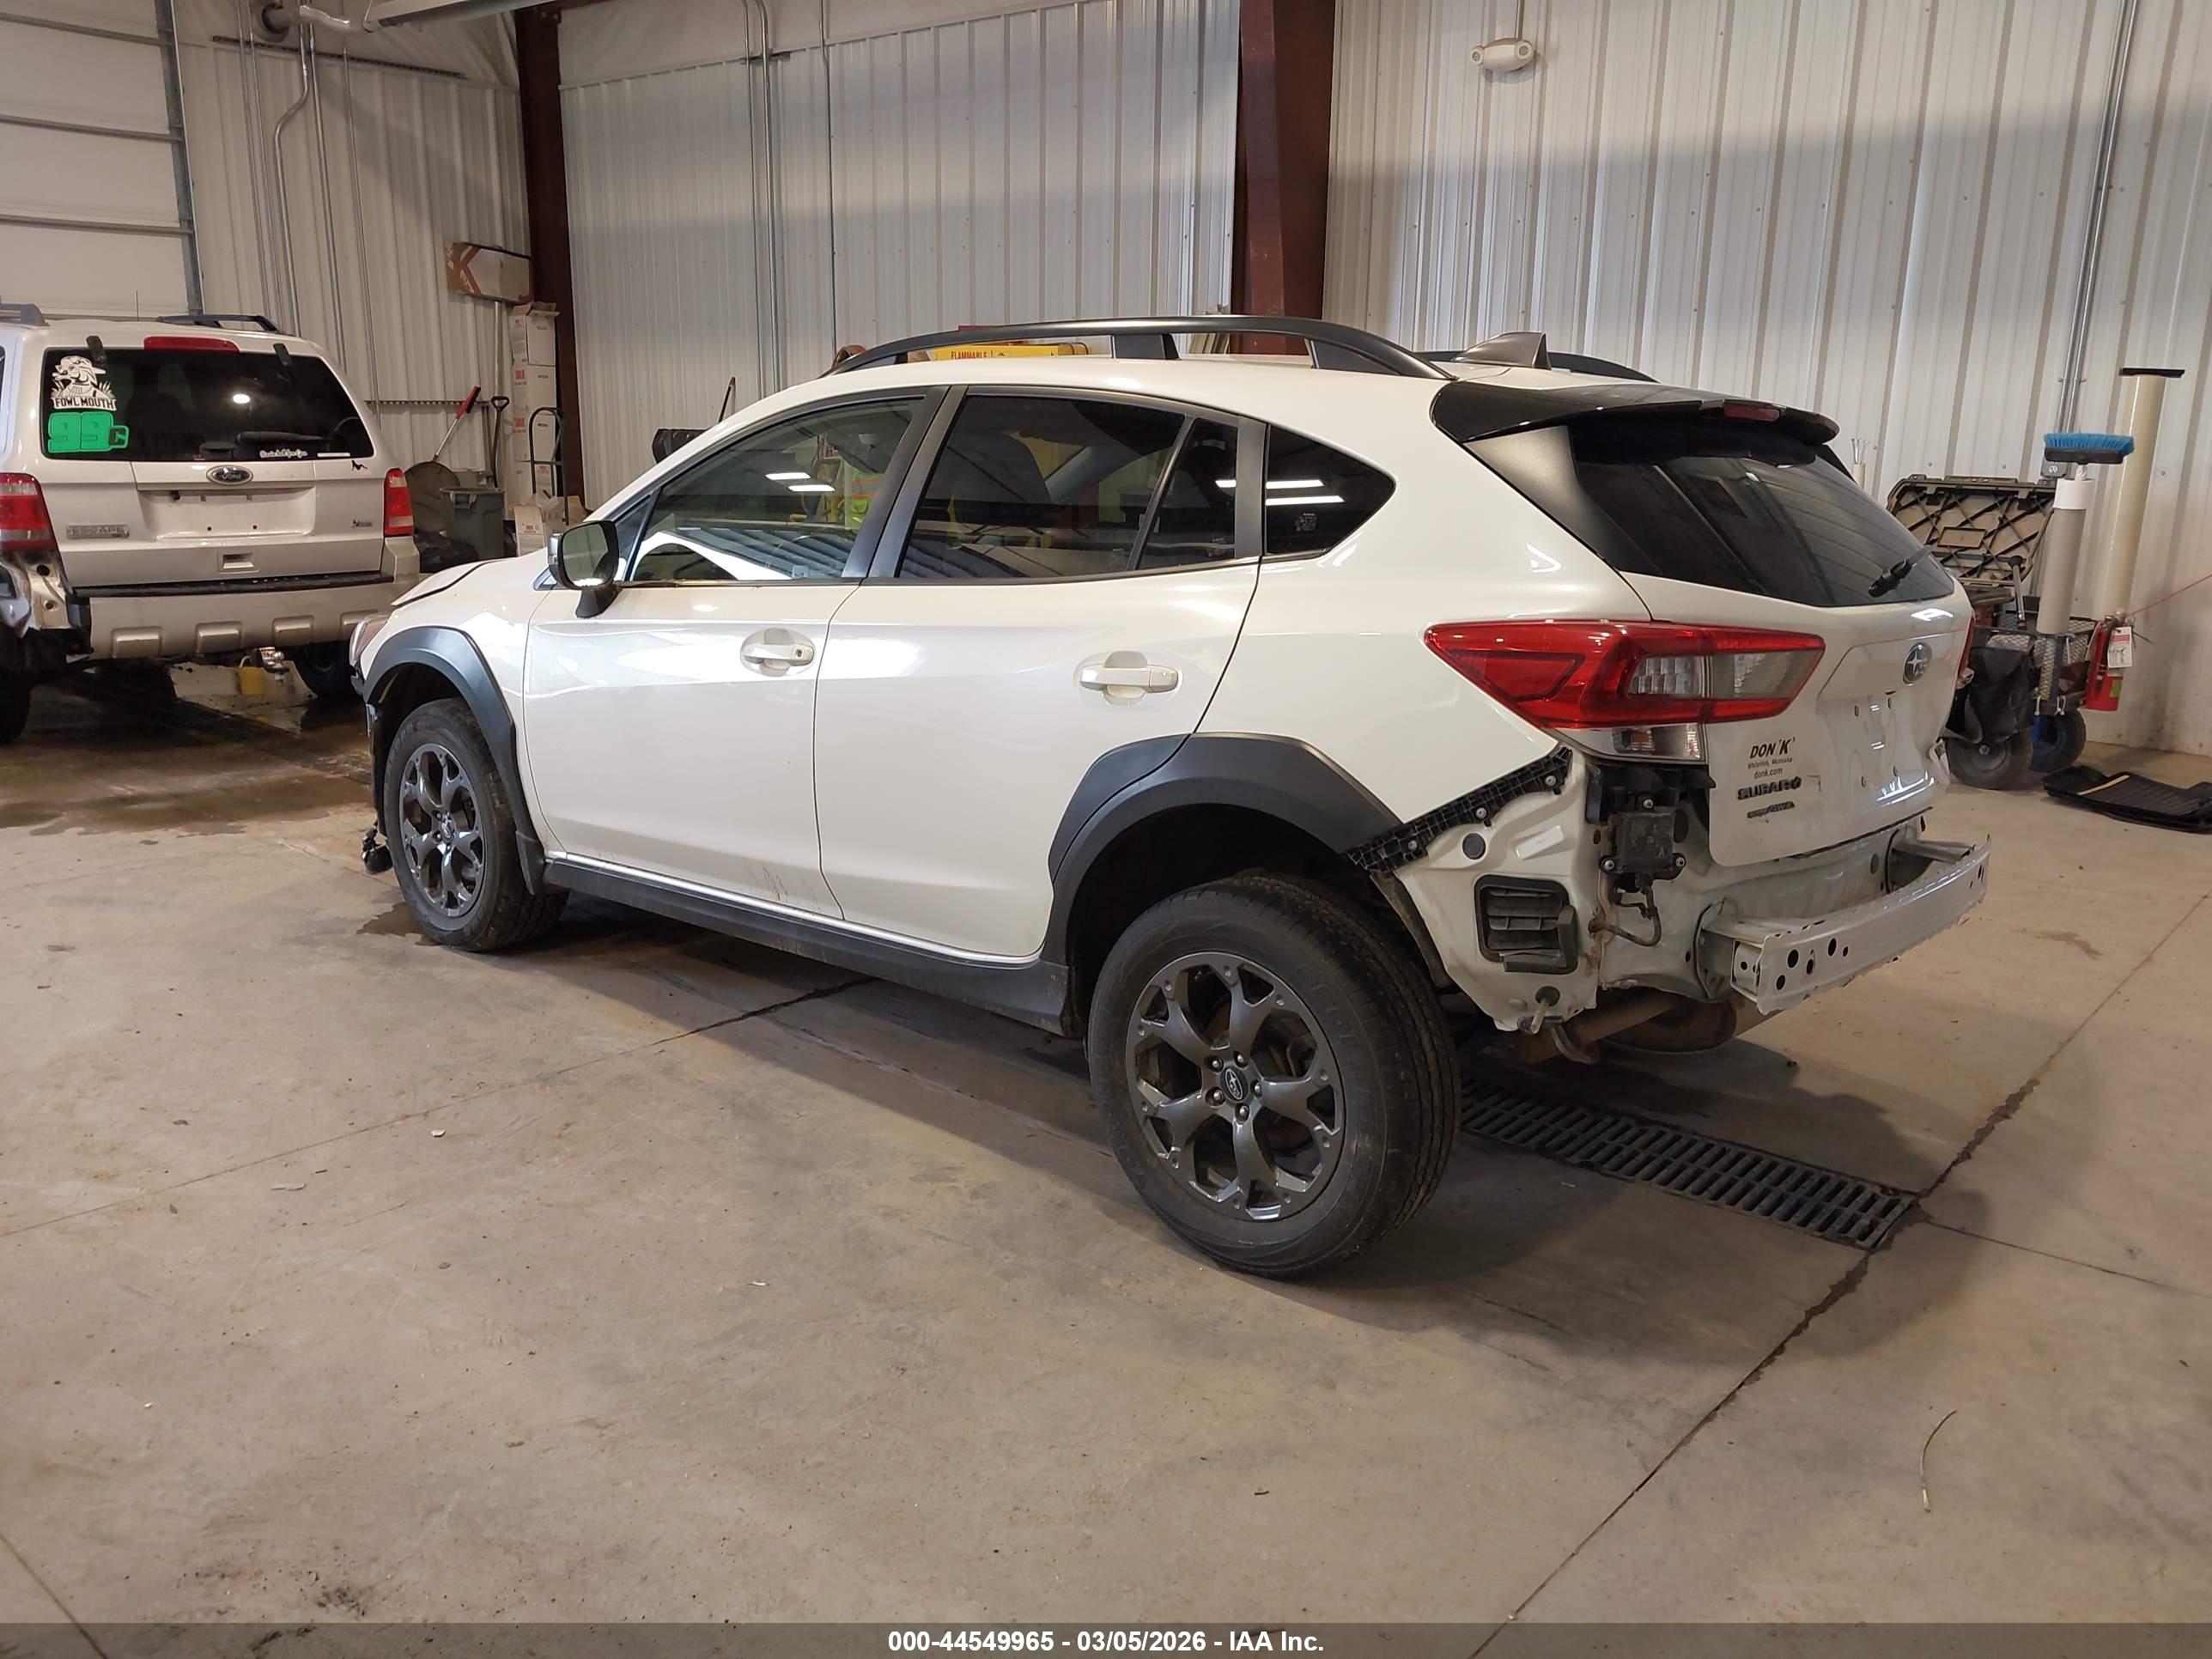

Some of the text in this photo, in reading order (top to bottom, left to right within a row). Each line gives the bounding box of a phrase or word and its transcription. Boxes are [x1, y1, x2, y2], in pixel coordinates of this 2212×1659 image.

[55, 397, 113, 410] FOWL MOUTH
[1749, 742, 1777, 759] DON
[1753, 768, 1784, 779] donk.com
